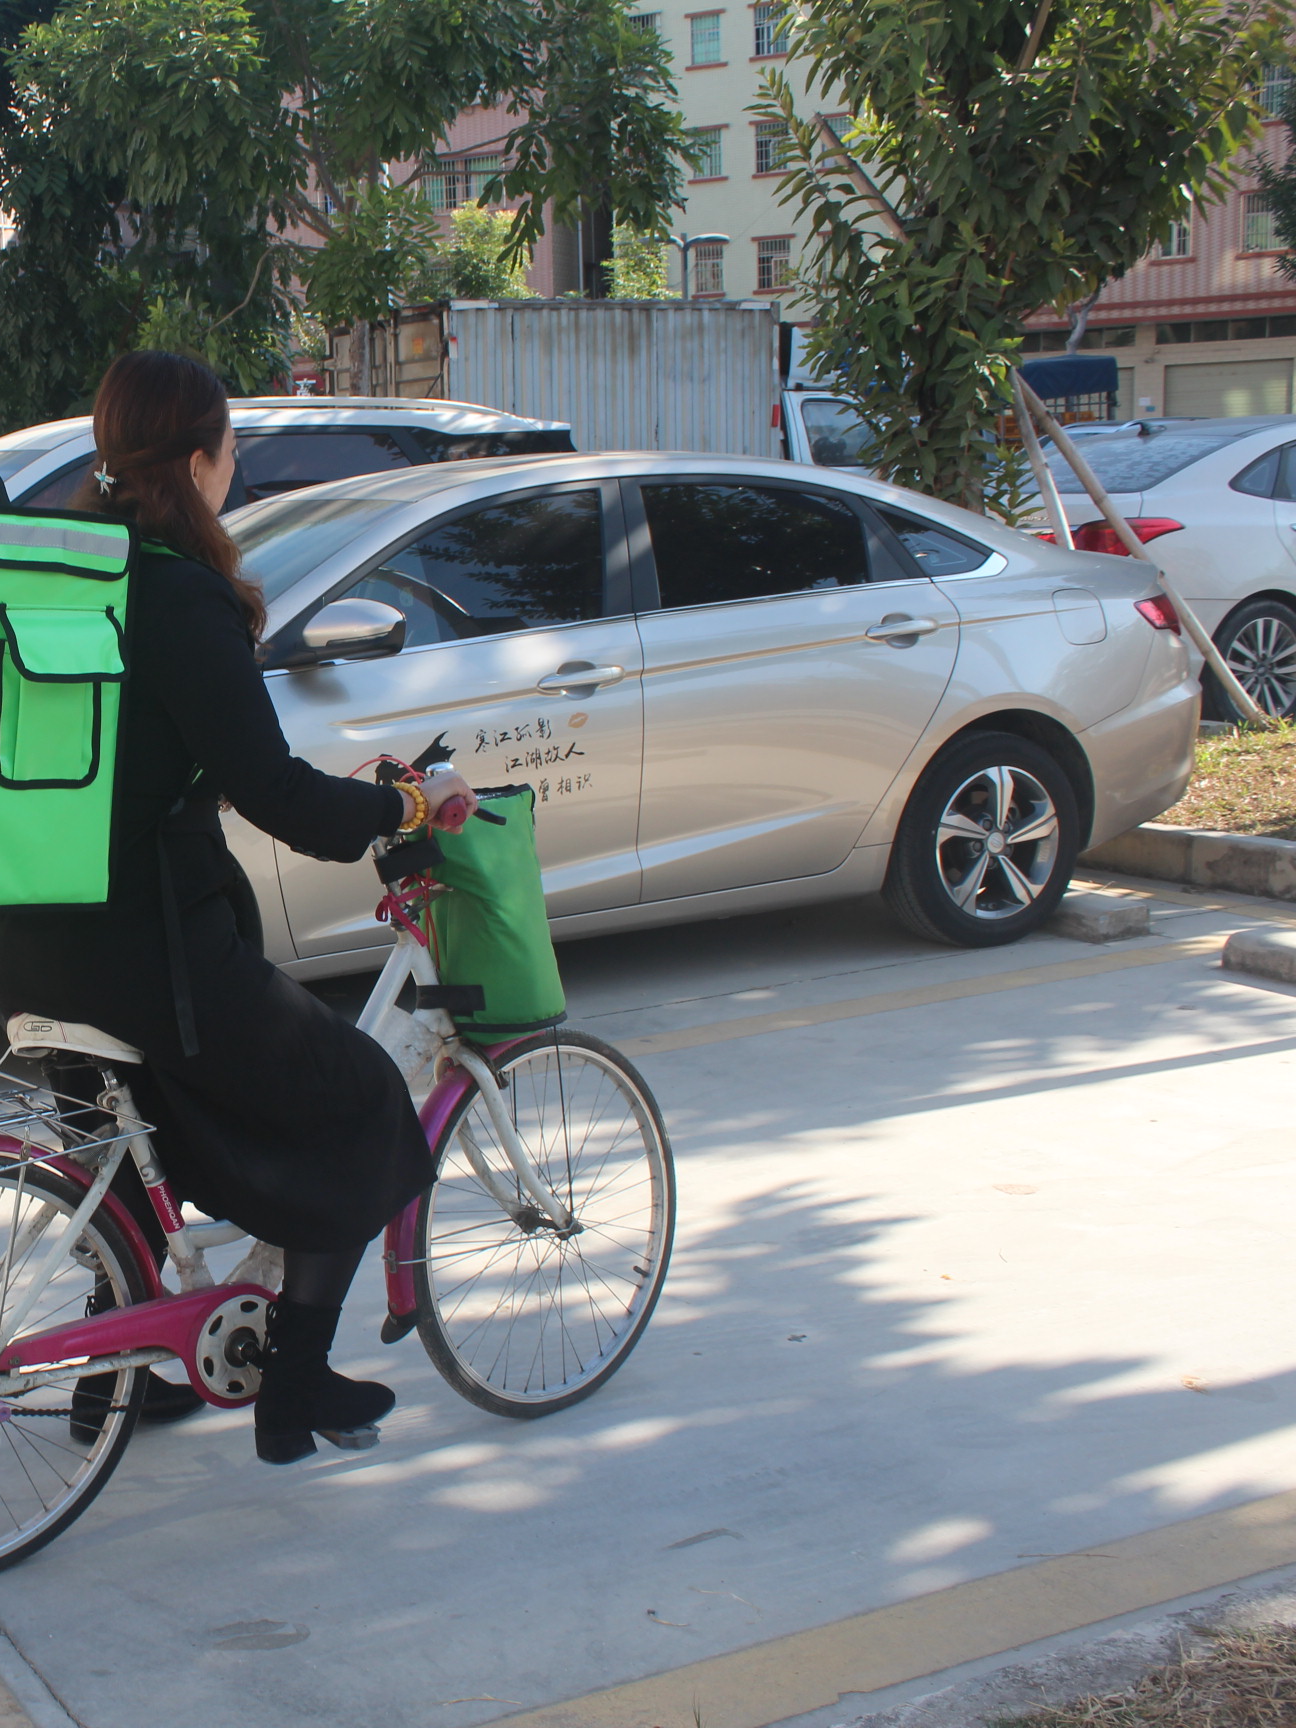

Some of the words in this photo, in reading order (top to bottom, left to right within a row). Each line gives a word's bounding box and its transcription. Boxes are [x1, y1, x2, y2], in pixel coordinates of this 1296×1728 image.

[475, 717, 552, 754] 寒江孤影
[505, 741, 585, 773] 江湖故人
